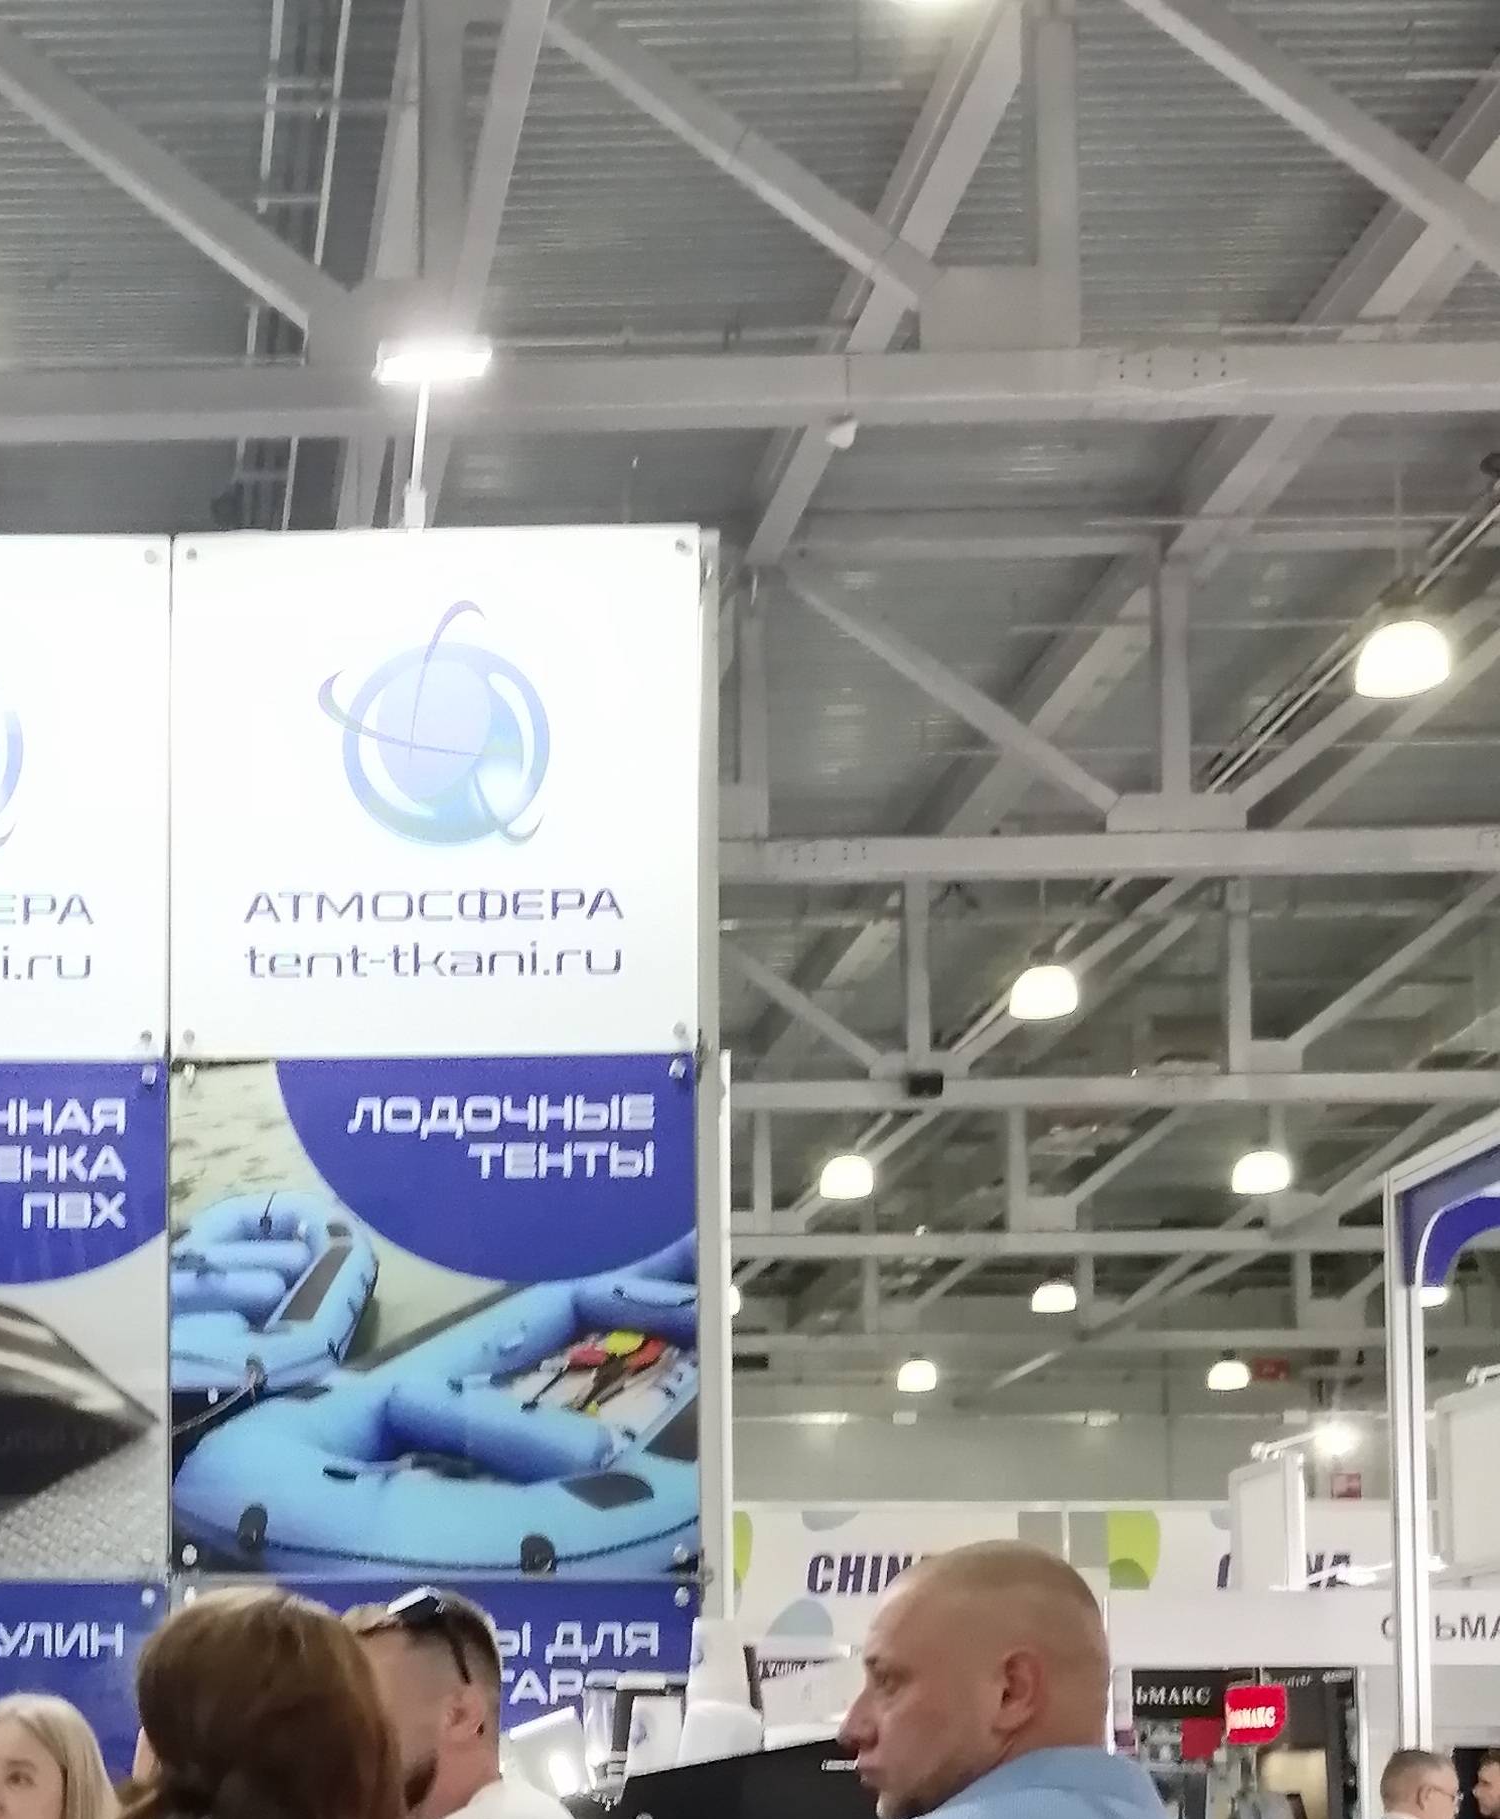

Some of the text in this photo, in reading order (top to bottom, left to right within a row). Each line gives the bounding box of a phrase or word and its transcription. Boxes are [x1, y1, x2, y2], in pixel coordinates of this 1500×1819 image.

[243, 887, 625, 923] АТМОСФЕРА
[244, 940, 623, 978] tent-tkani.ru
[346, 1093, 656, 1140] ЛОДОЧНЫЕ
[467, 1141, 656, 1180] ТЕНТЫ
[21, 1191, 127, 1230] ПВХ
[544, 1620, 660, 1665] ДЛЯ
